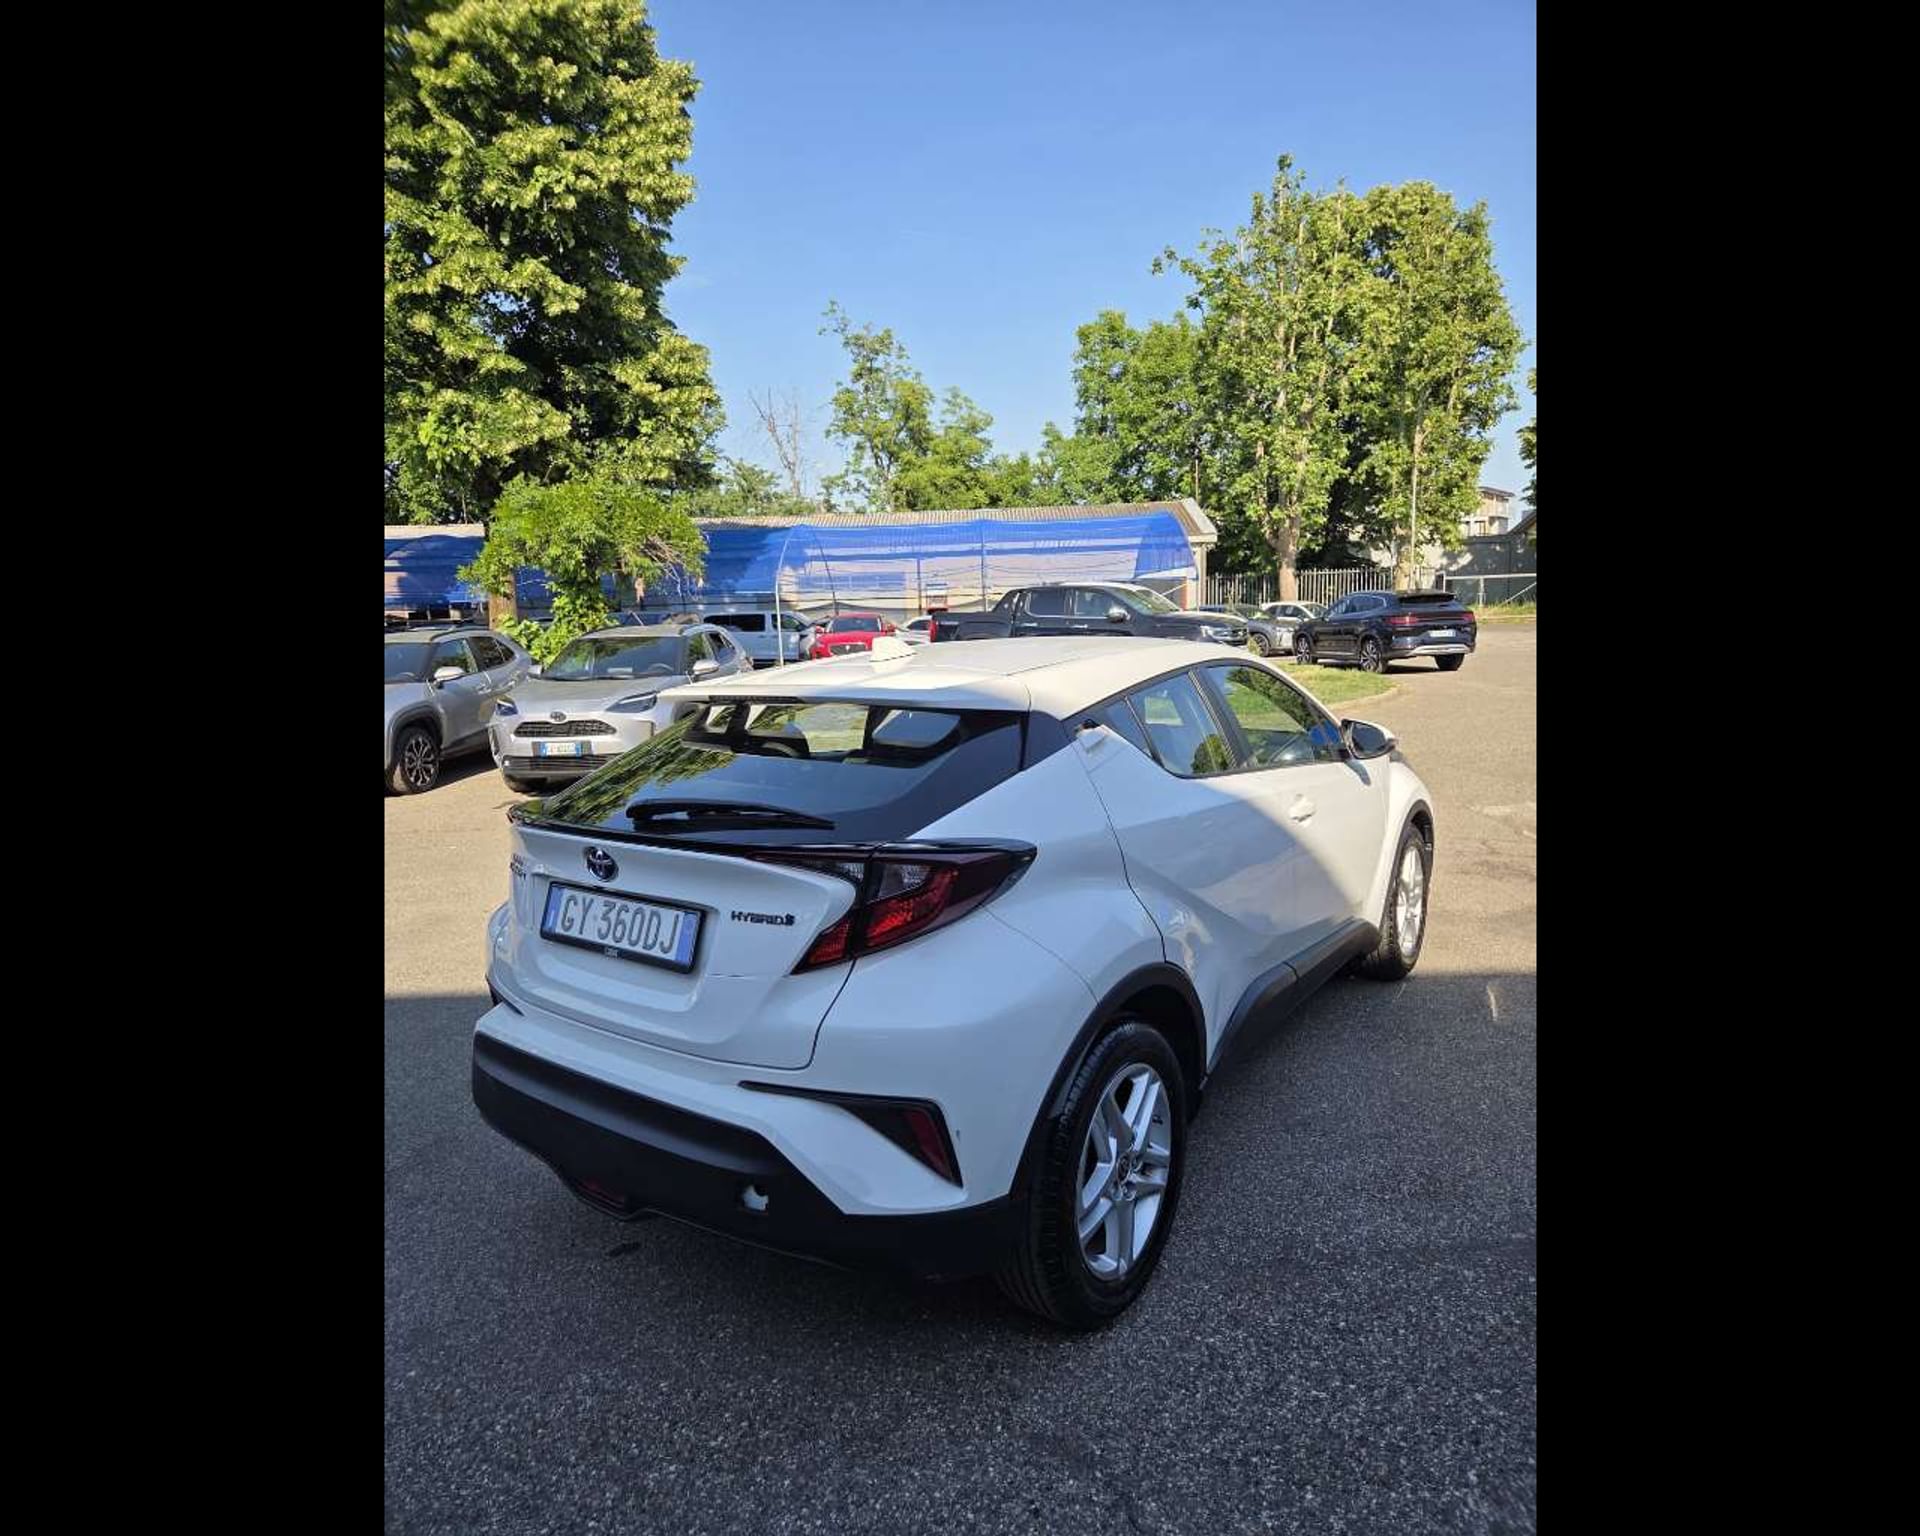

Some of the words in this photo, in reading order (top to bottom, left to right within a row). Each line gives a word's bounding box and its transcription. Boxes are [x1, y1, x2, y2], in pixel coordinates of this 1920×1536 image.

[560, 894, 595, 935] GY
[597, 900, 677, 954] 360DJ
[731, 910, 785, 925] HYBRID
